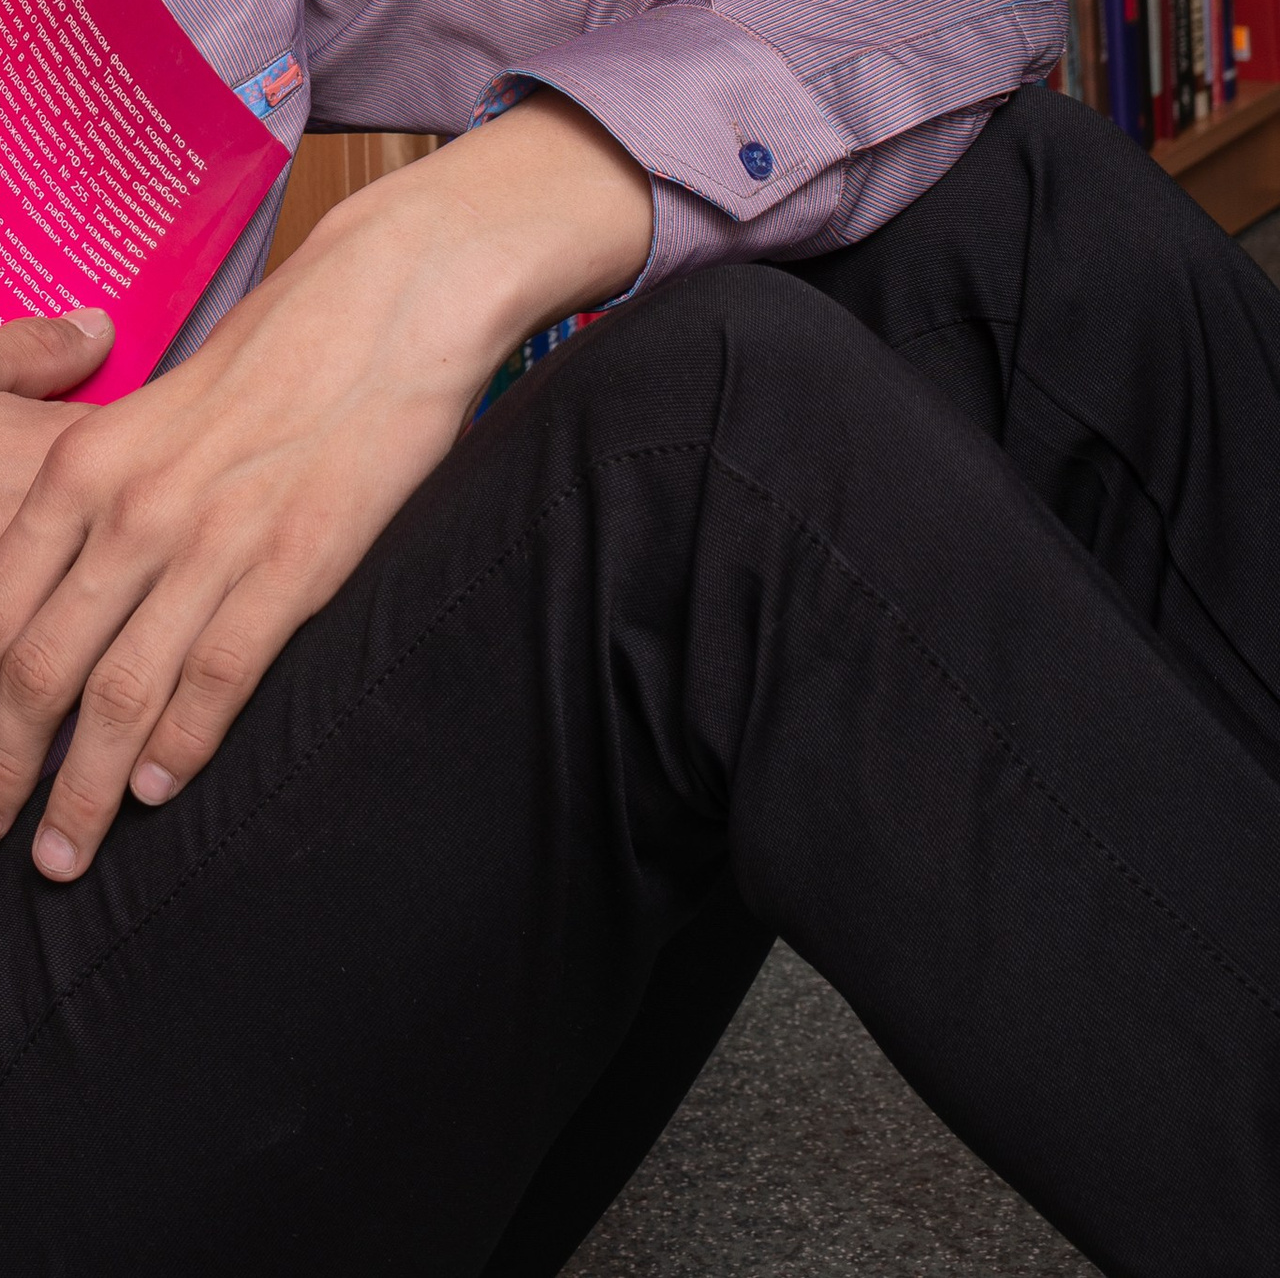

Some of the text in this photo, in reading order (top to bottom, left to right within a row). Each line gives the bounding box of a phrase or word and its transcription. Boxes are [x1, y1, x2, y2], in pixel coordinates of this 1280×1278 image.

[56, 28, 91, 78] примеры
[88, 76, 136, 138] заполнения
[132, 135, 191, 196] унифициро-
[63, 13, 103, 68] редакцию
[103, 66, 145, 124] Трудового
[144, 124, 183, 171] кодекса,
[186, 170, 201, 186] на
[109, 53, 134, 85] форм
[132, 84, 172, 134] приказов
[171, 132, 186, 149] по
[186, 148, 208, 171] кад-
